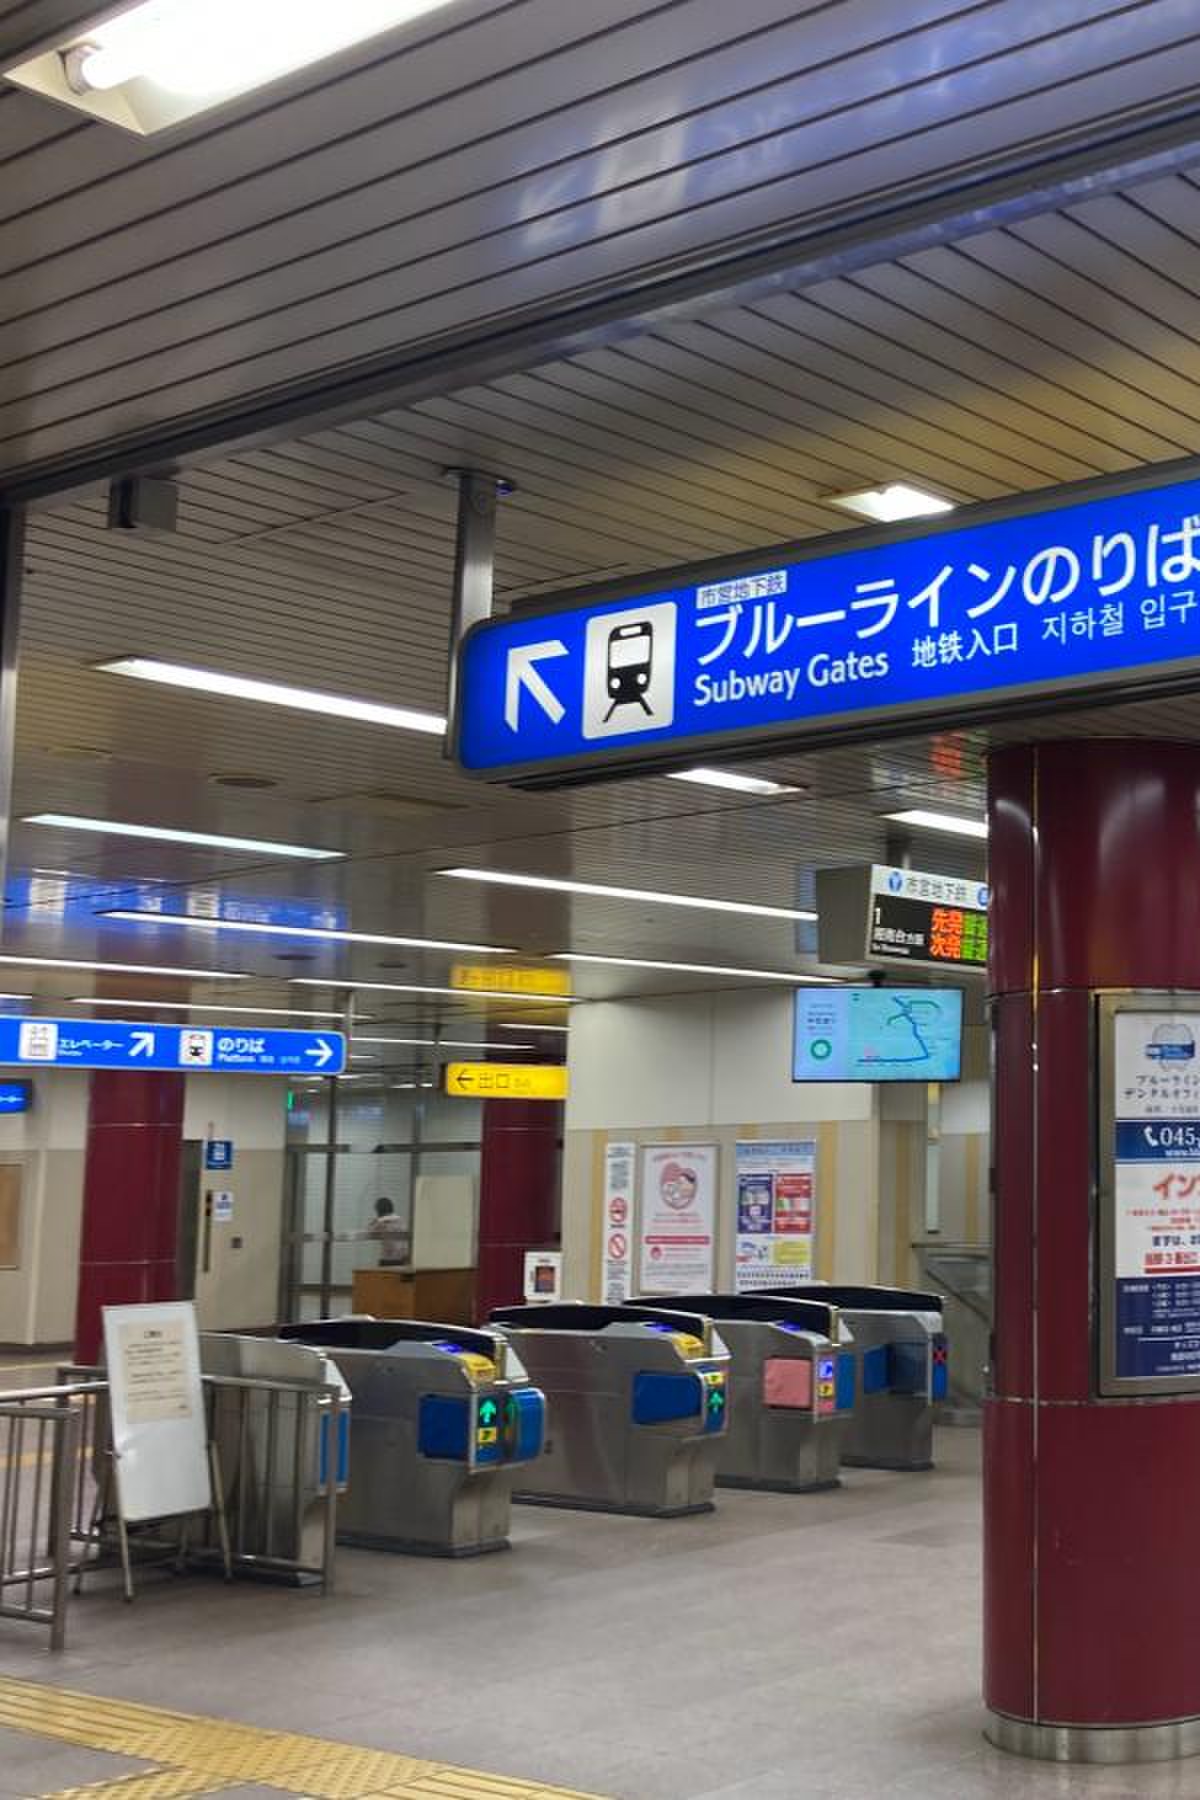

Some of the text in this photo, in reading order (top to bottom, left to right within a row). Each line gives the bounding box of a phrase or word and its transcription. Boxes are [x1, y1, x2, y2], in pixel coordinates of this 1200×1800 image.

[1042, 591, 1198, 643] 지하철 입구
[911, 623, 1018, 668] 地铁入口
[694, 650, 889, 706] Subway Gates
[217, 1037, 266, 1054] のりば
[479, 1072, 511, 1090] 出口
